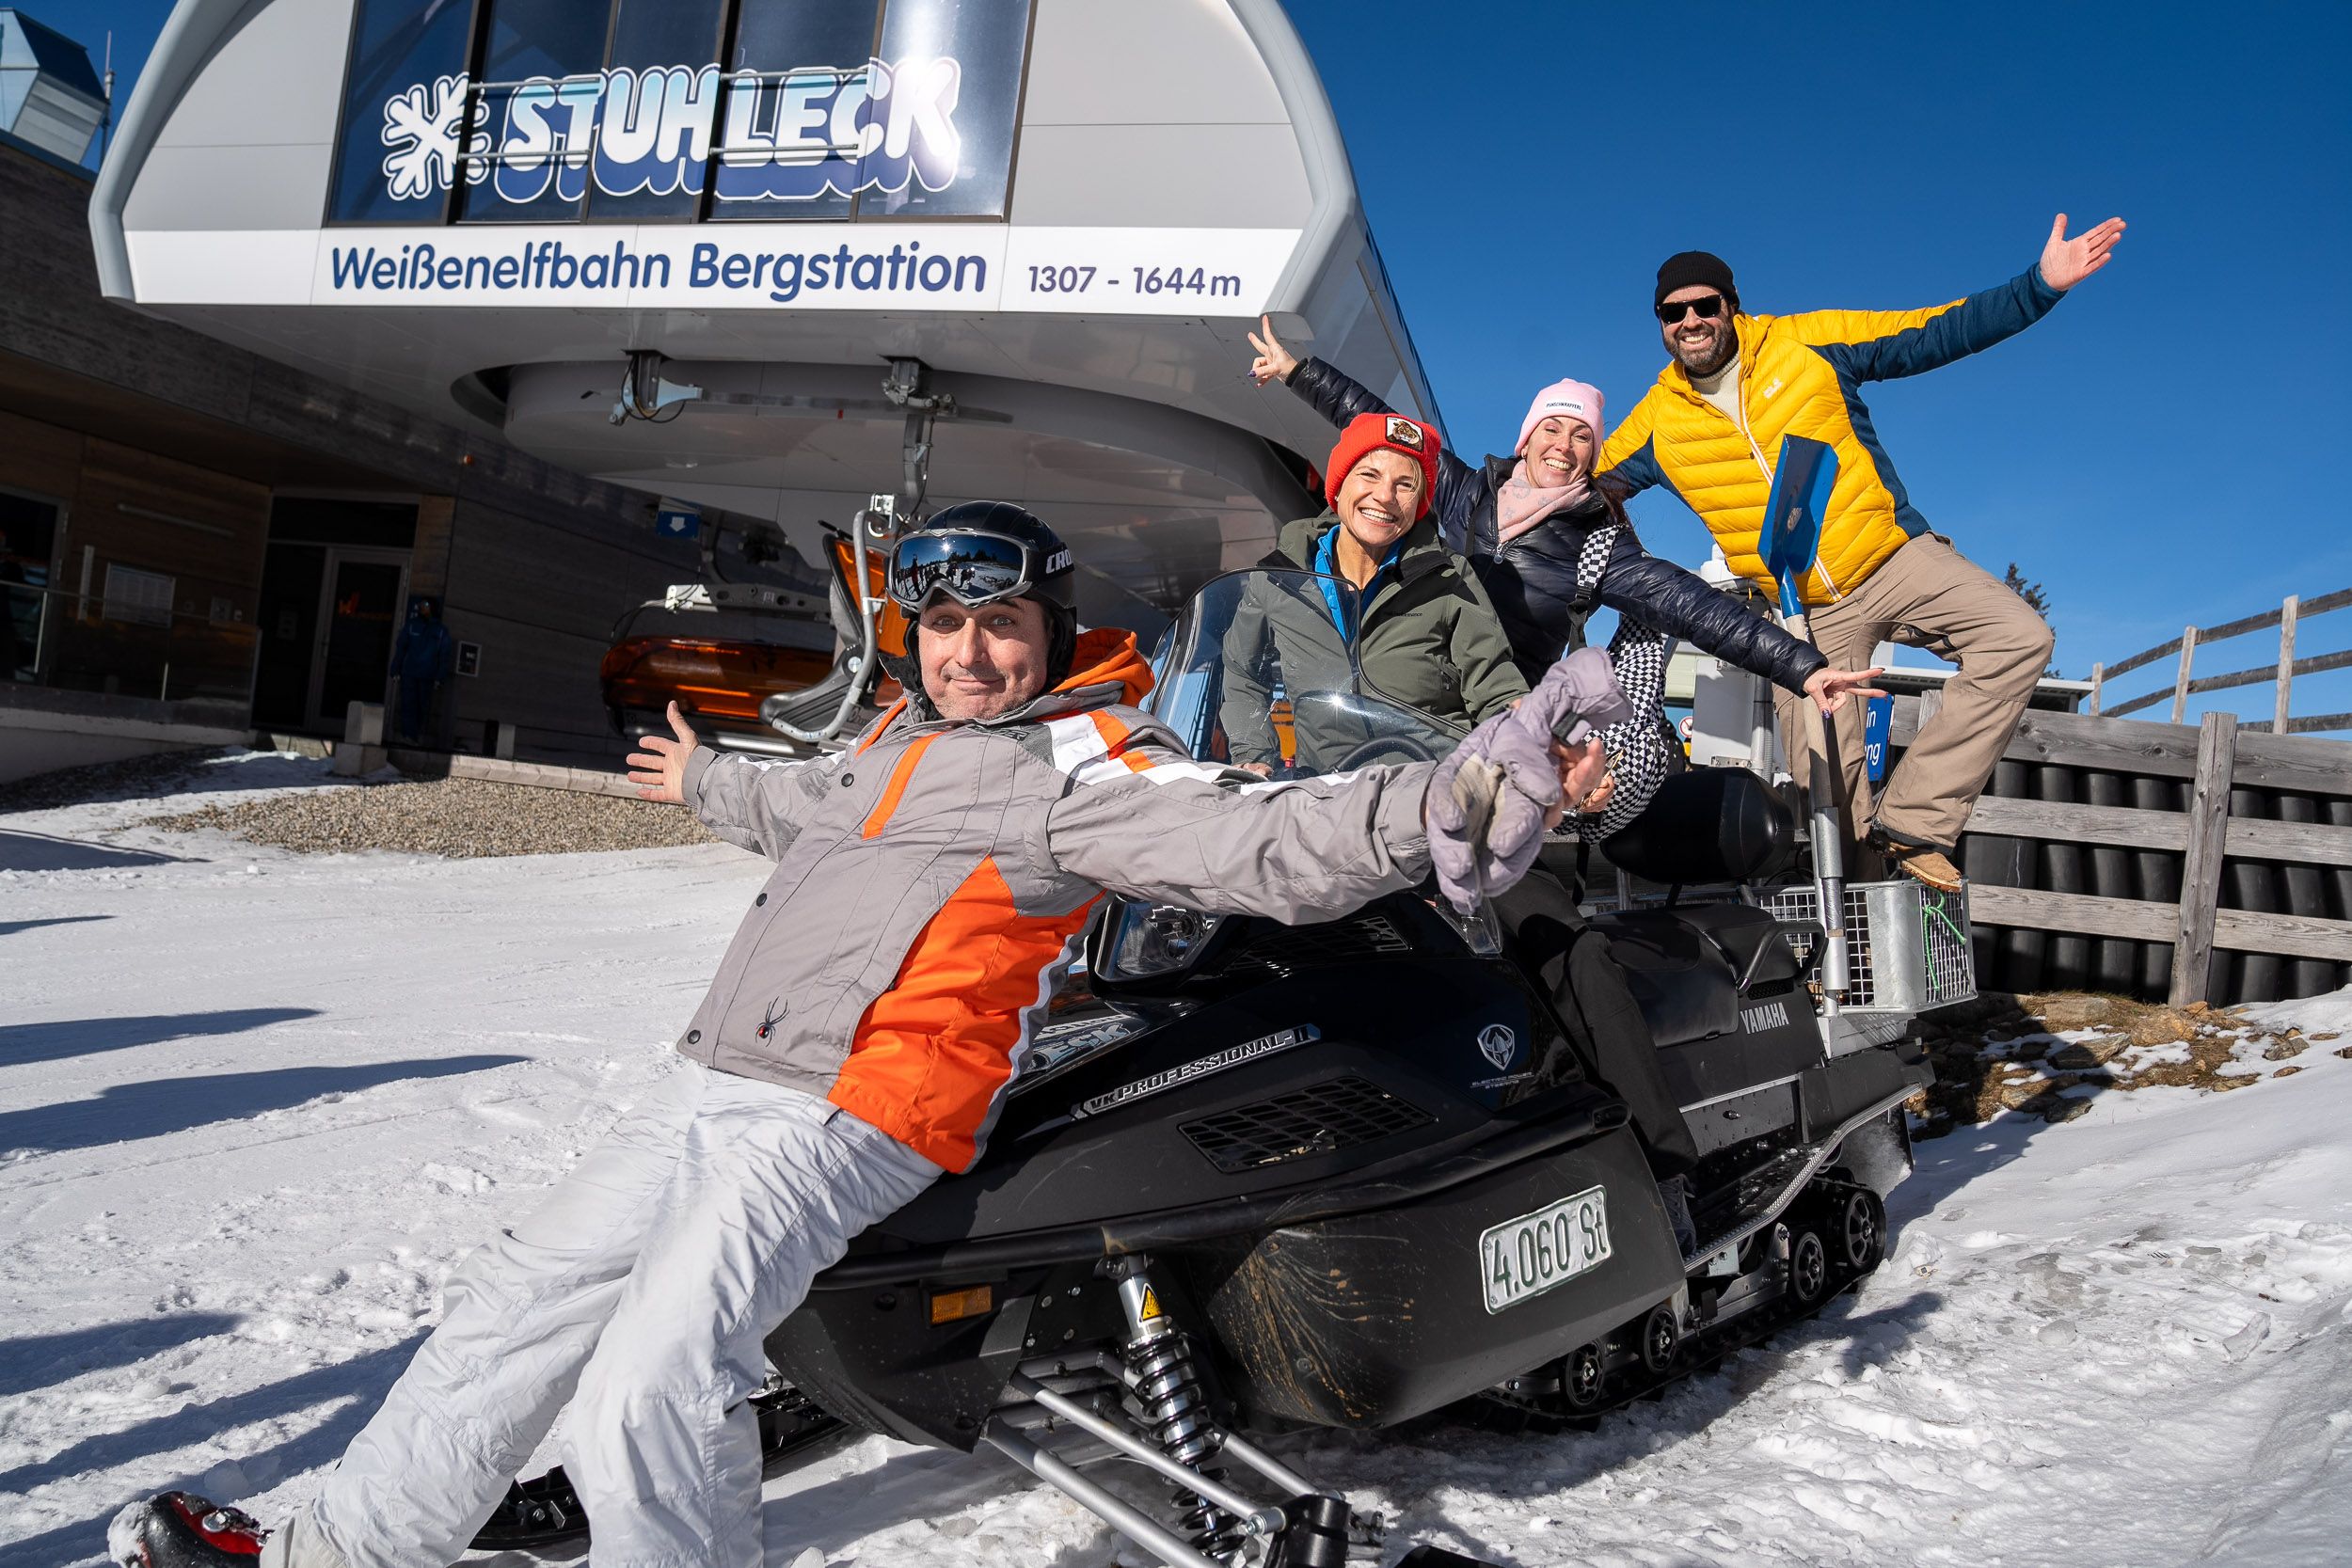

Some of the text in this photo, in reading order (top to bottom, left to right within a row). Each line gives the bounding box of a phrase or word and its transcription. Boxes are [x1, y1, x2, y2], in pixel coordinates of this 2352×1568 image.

[495, 57, 961, 203] STUHLECK
[333, 240, 671, 290] Weißenelfbahn
[689, 241, 987, 303] Bergstation
[1028, 265, 1097, 293] 1307
[1740, 1002, 1789, 1035] YAMAHA
[1492, 1203, 1607, 1298] 4.060 St
